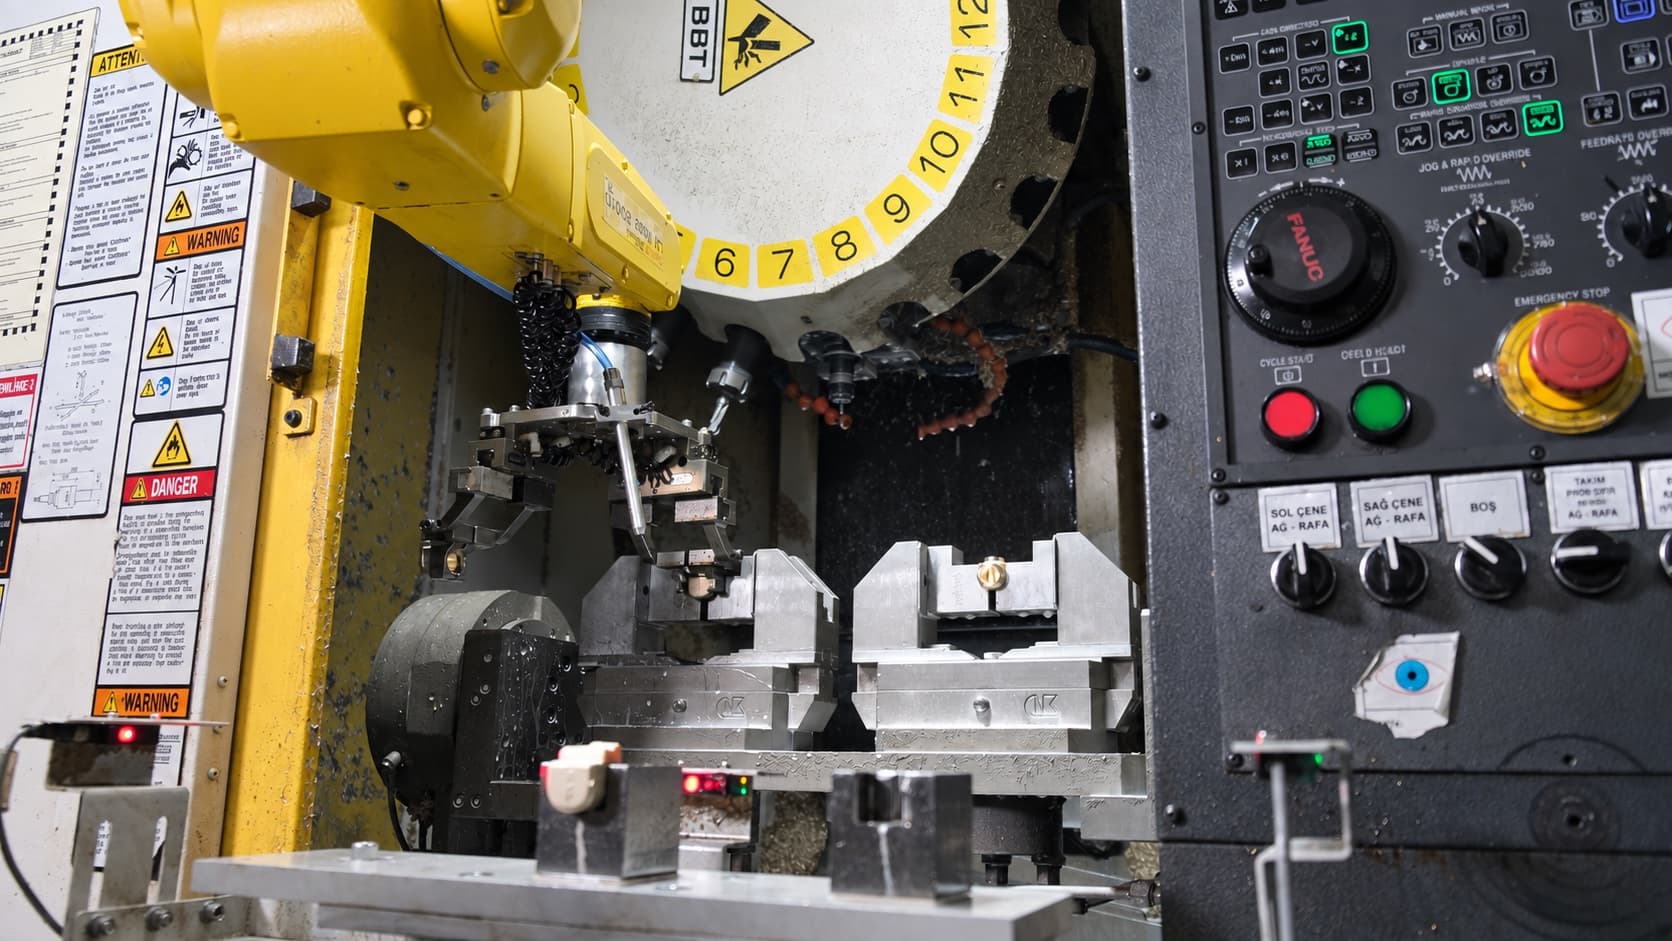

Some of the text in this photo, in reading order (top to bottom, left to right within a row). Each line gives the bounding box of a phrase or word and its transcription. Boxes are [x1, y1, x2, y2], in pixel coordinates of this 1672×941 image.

[957, 0, 989, 38] 12
[689, 6, 710, 68] BBT
[948, 67, 985, 107] 11
[919, 130, 960, 174] 10
[1419, 162, 1439, 173] JOG
[1482, 148, 1532, 163] OVERRIDE
[883, 193, 911, 223] 9
[187, 226, 240, 250] WARNING
[831, 230, 858, 262] 8
[1286, 212, 1324, 282] FANUC
[714, 248, 736, 278] 6
[771, 248, 795, 280] 7
[1514, 286, 1610, 307] EMERGENCY STOP
[151, 475, 198, 497] DANGER
[1271, 505, 1327, 518] SOL ÇENE
[1363, 497, 1424, 512] SAĞ ÇENE
[1470, 501, 1497, 514] BOŞ
[1298, 519, 1329, 531] RAFA
[1394, 512, 1426, 524] RAFA
[124, 692, 179, 713] WARNING
